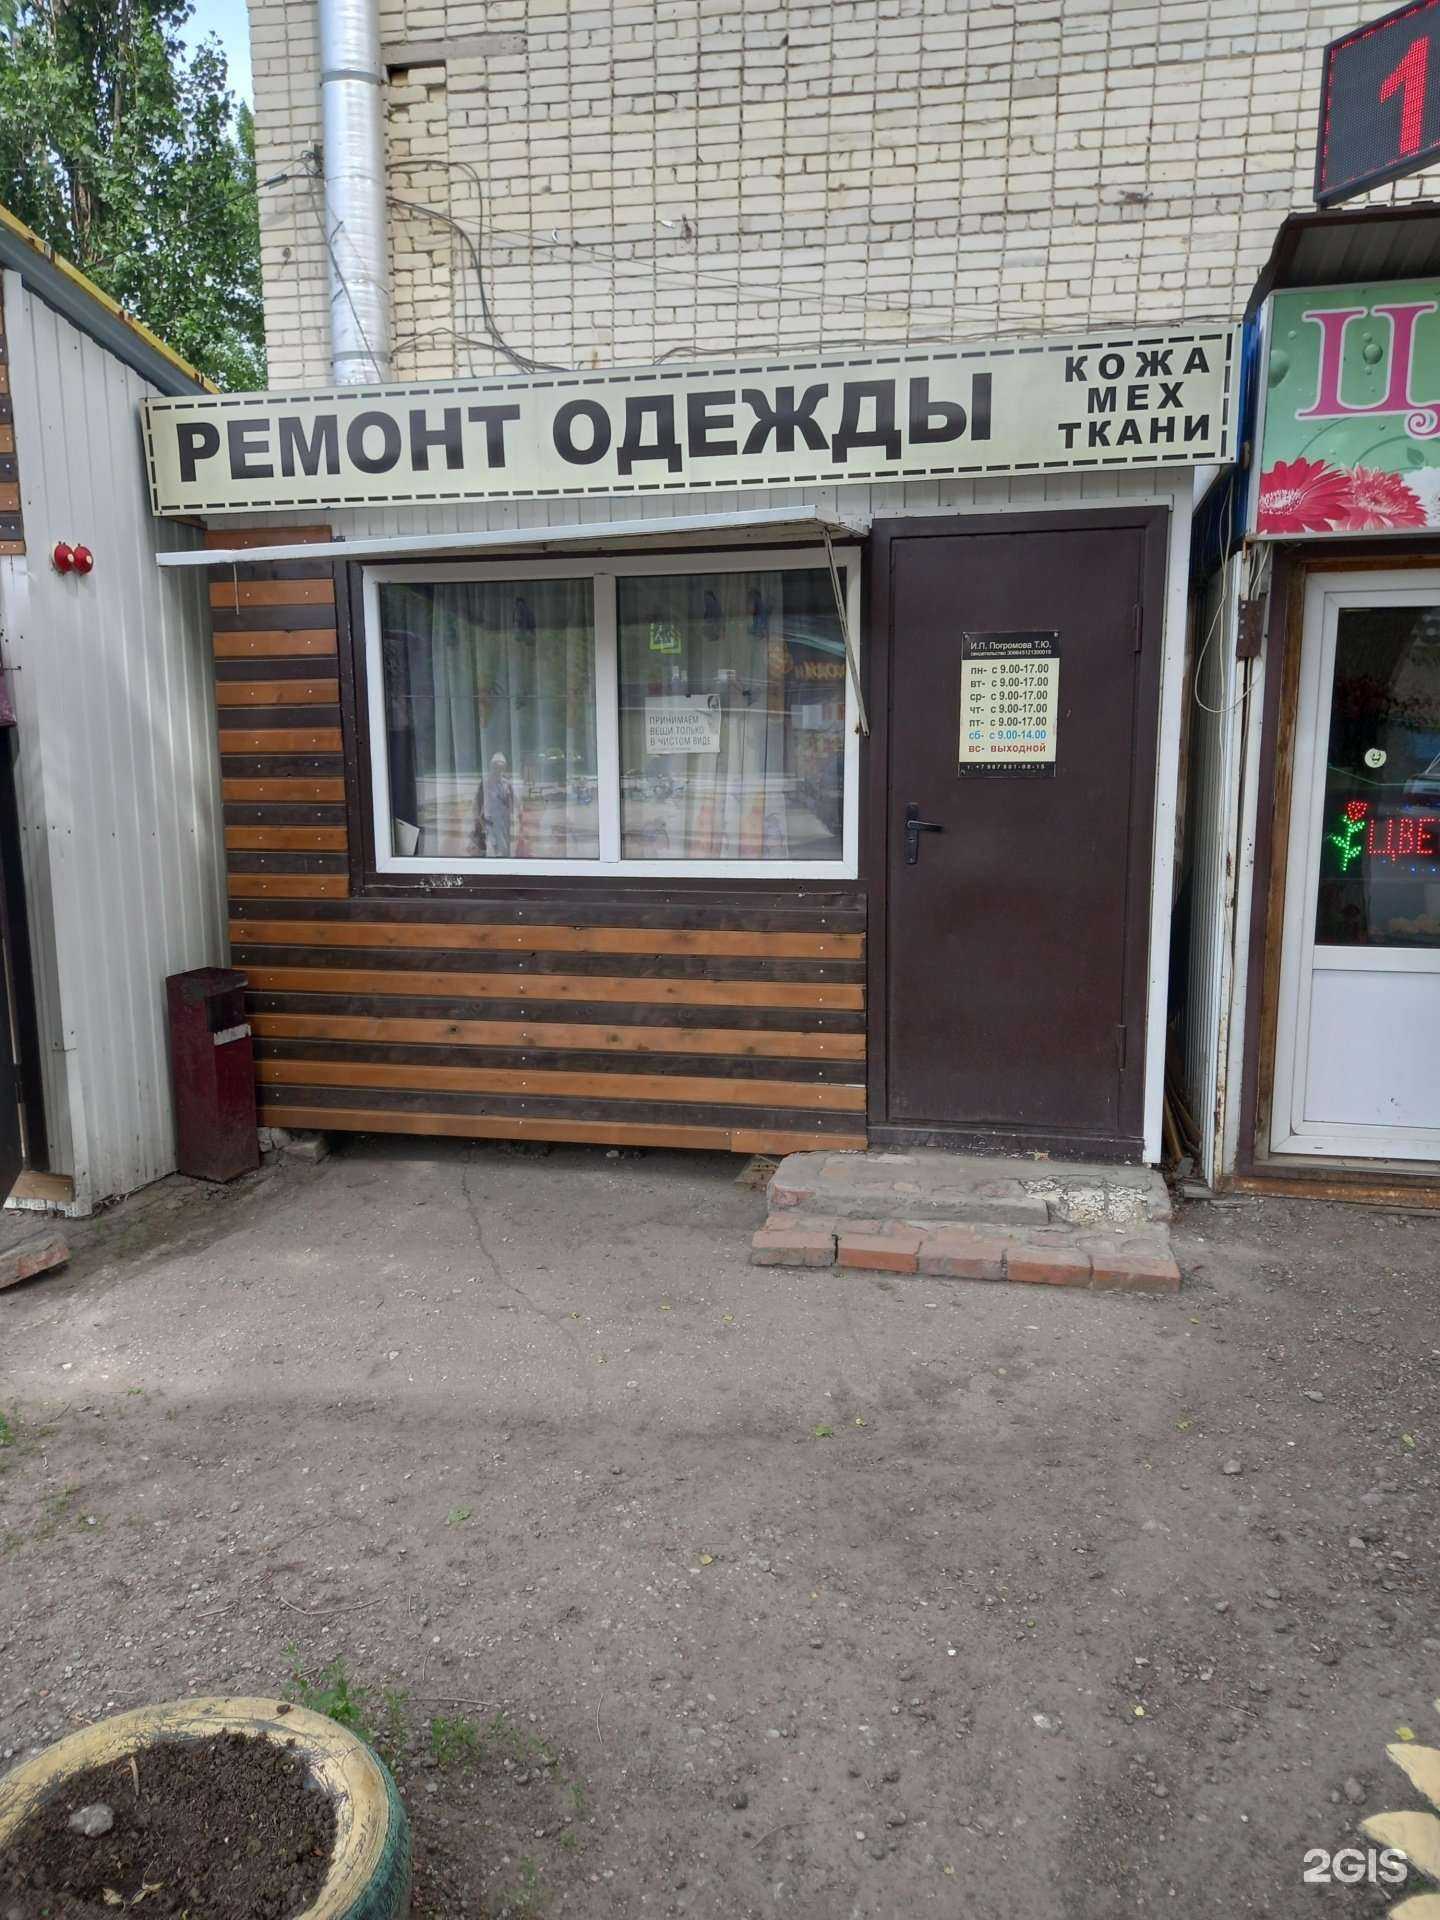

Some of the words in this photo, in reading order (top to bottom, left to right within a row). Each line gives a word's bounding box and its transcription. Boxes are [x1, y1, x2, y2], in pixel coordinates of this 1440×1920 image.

[1380, 36, 1429, 154] 1
[1064, 346, 1210, 384] КОЖА
[1087, 381, 1184, 415] МЕХ
[176, 403, 520, 483] РЕМОНТ
[552, 372, 993, 477] ОДЕЖДЫ
[1057, 414, 1210, 450] ТКАНИ
[970, 667, 987, 675] пн-
[1000, 663, 1049, 675] 9.00-17.00
[970, 680, 986, 688] вт-
[999, 677, 1049, 688] 9.00-17.00
[970, 693, 985, 703] ср-
[999, 690, 1048, 701] 9.00-17.00
[970, 706, 984, 715] чт-
[998, 703, 1048, 714] 9.00-17.00
[649, 715, 699, 725] ПРИНИМАЕМ
[969, 719, 984, 727] пт-
[998, 716, 1047, 727] 9.00-17.00
[650, 727, 673, 736] ВЕЩИ
[676, 726, 704, 736] ТОЛЬКО
[969, 730, 984, 740] сб-
[997, 729, 1046, 740] 9.00-14.00
[658, 736, 691, 745] ЧИСТОМ
[693, 736, 711, 745] ВИДЕ
[968, 744, 985, 753] вс-
[990, 742, 1046, 753] выходной
